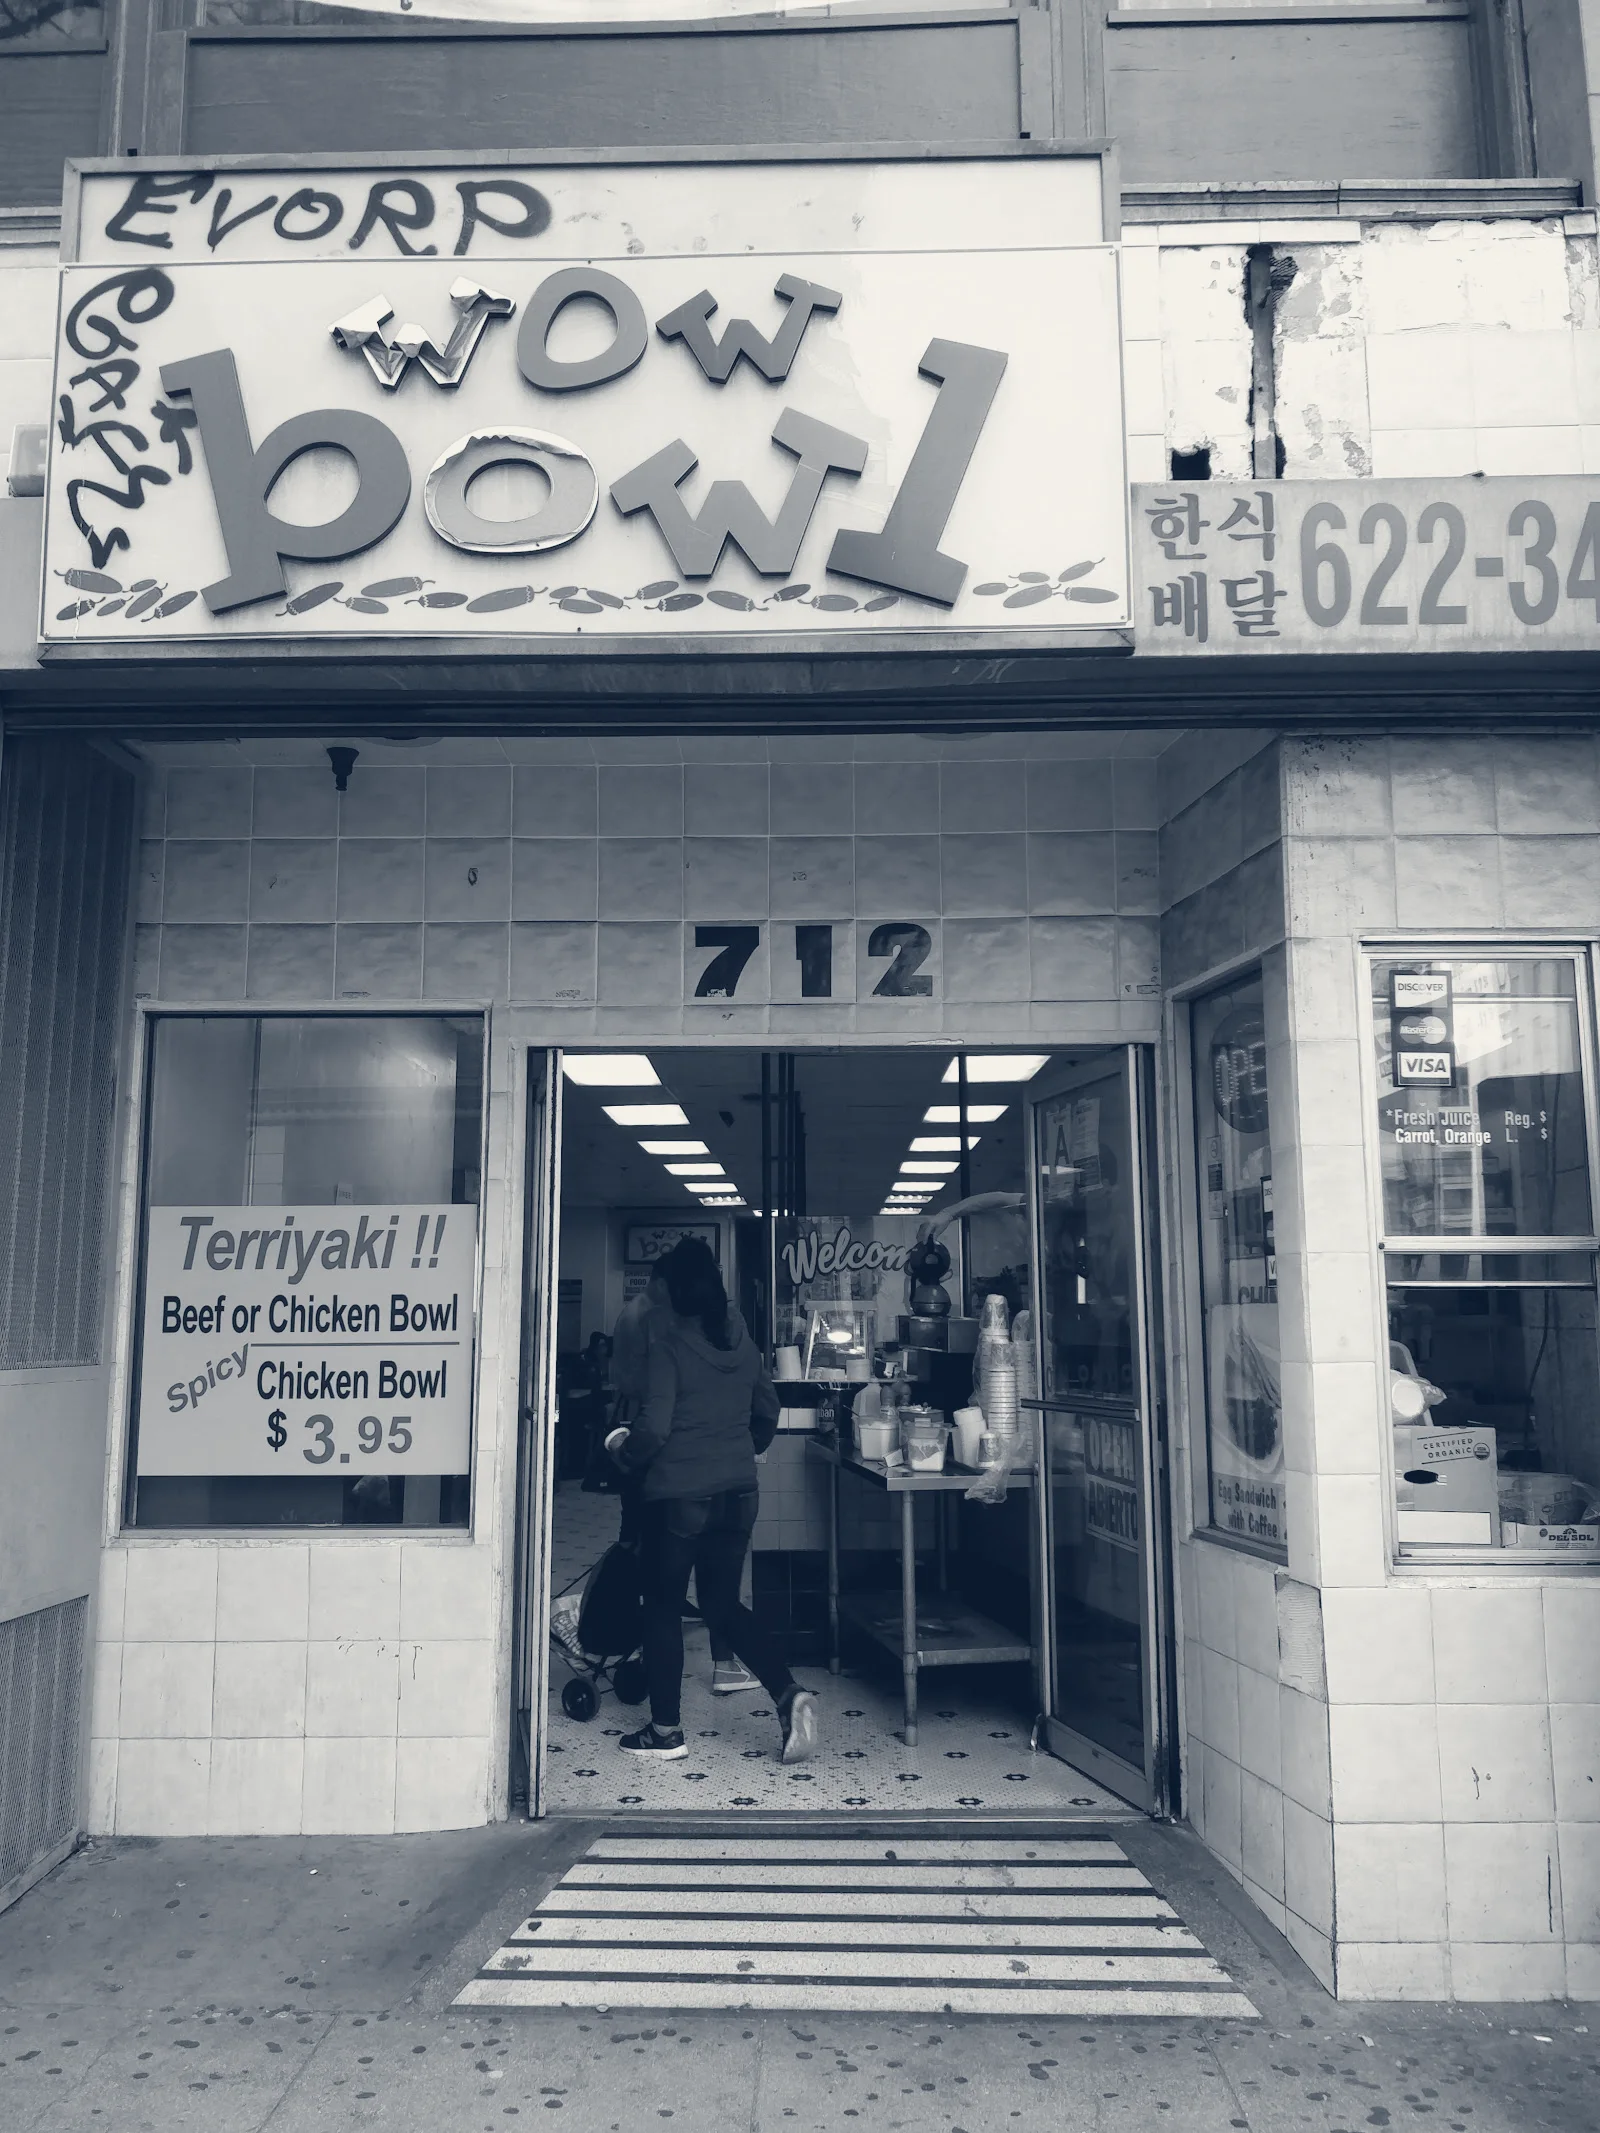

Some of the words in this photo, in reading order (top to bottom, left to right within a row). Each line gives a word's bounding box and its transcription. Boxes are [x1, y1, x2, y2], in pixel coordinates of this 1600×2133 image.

[1144, 490, 1277, 562] 한식
[1147, 570, 1288, 643] 배달
[694, 922, 933, 998] 712
[1397, 982, 1444, 992] DISCOVER
[1406, 1058, 1447, 1073] VISA
[1441, 1112, 1480, 1126] Juice
[1505, 1110, 1535, 1129] Reg.
[1395, 1128, 1440, 1145] Carrot,
[1445, 1128, 1492, 1147] Orange
[180, 1216, 399, 1285] Terriyaki
[162, 1295, 226, 1334] Beef
[232, 1303, 261, 1333] or
[268, 1294, 380, 1333] Chicken
[390, 1293, 458, 1332] Bowl
[166, 1343, 250, 1413] Spicy
[257, 1361, 368, 1400] Chicken
[378, 1360, 447, 1399] Bowl
[302, 1414, 413, 1464] 3.95
[1423, 1438, 1473, 1450] CERTIFIED
[1428, 1447, 1472, 1459] ORGANIC
[1218, 1481, 1232, 1507] Egg
[1235, 1482, 1277, 1510] Sandwich
[1228, 1509, 1245, 1530] with
[1248, 1511, 1278, 1538] Coffee
